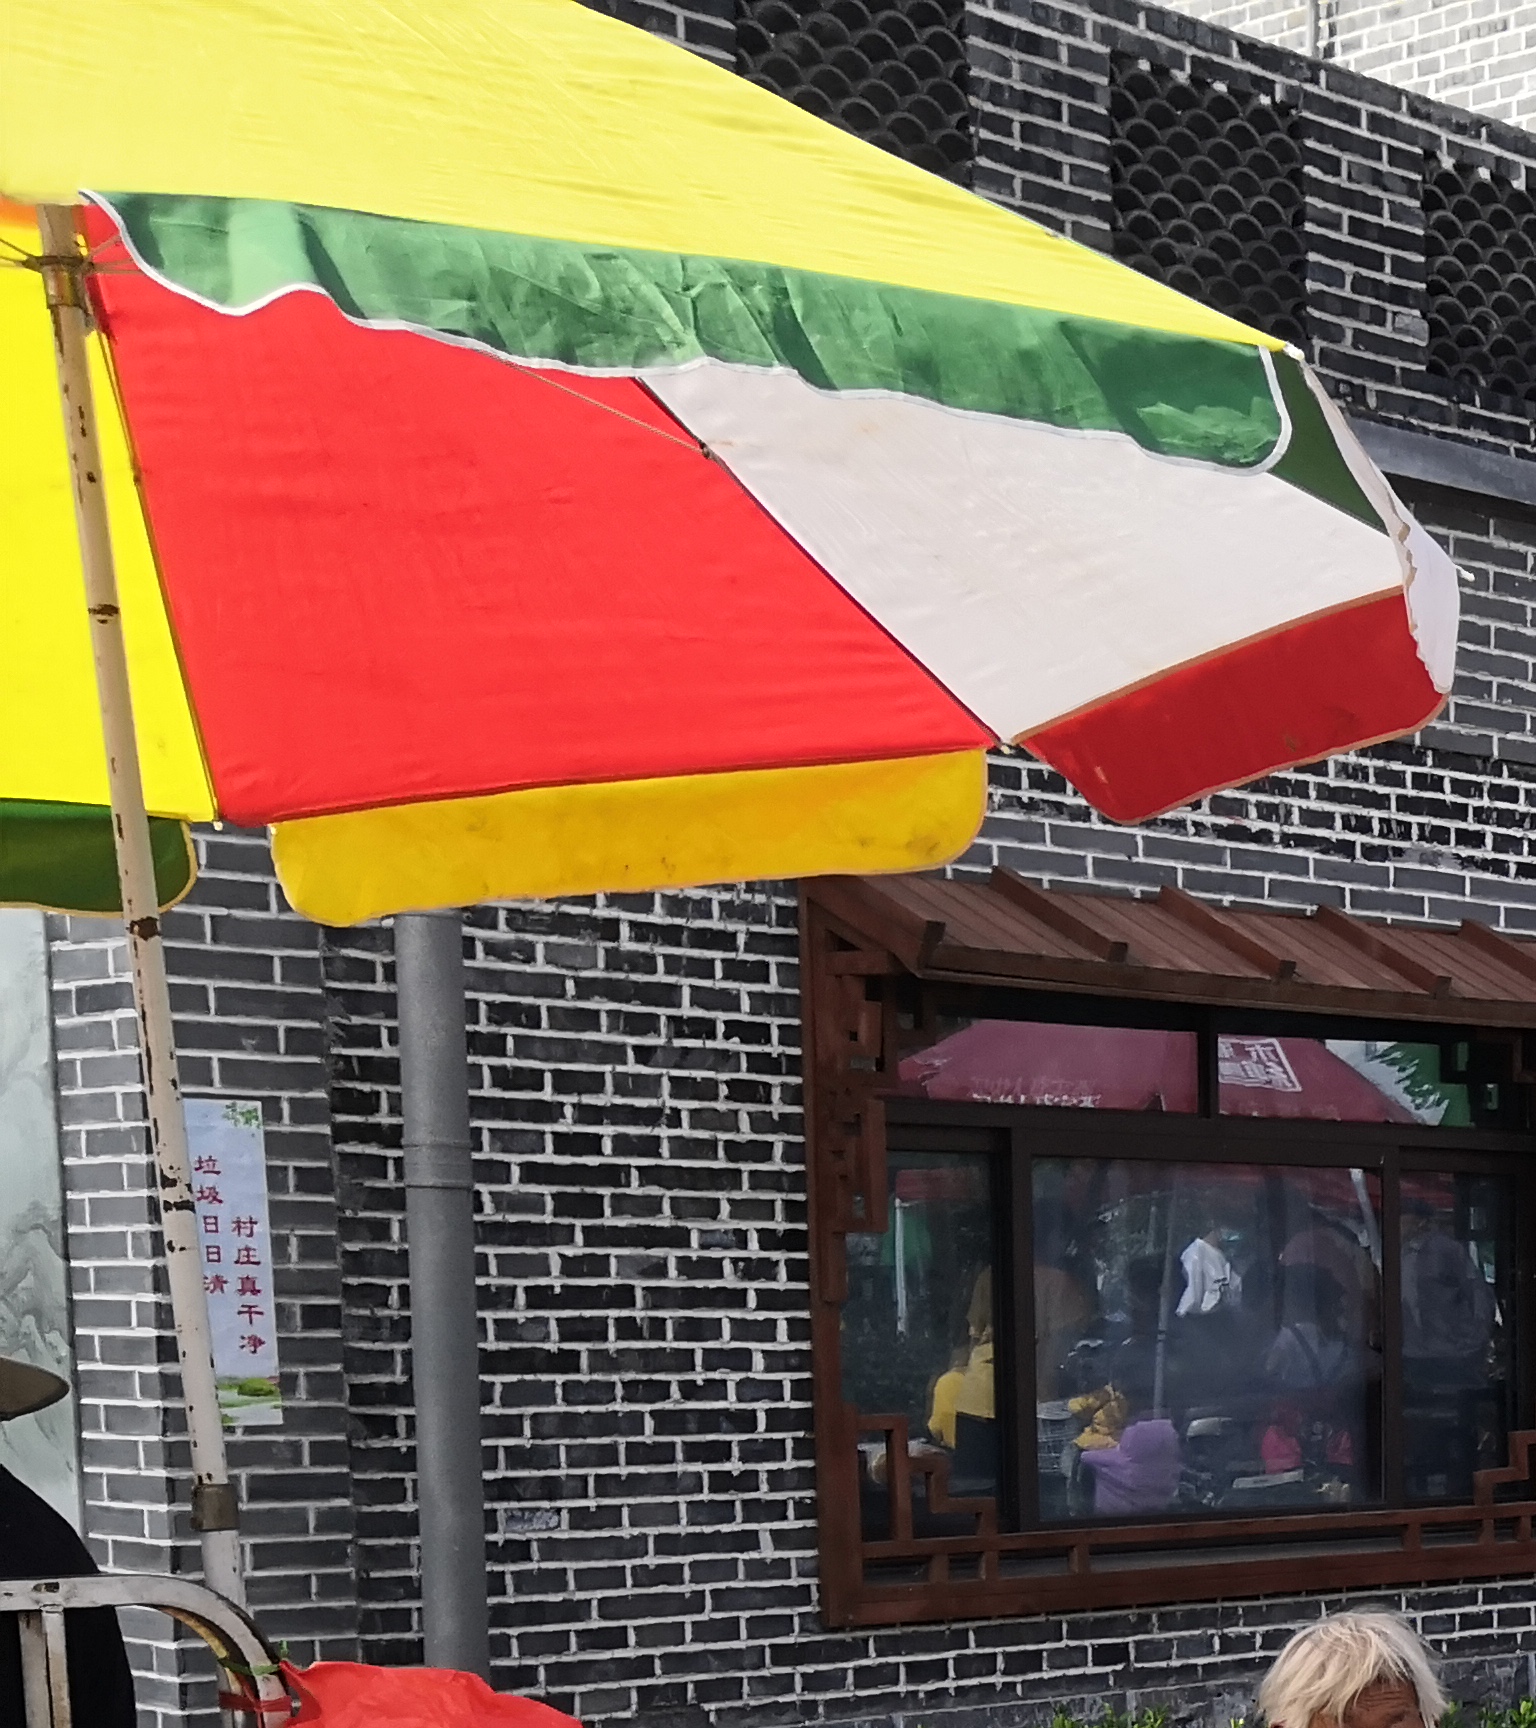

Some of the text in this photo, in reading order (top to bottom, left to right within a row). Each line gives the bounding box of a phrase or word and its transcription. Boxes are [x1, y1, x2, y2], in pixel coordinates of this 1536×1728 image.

[194, 1155, 229, 1295] 垃圾日日清
[231, 1216, 266, 1355] 村庄真干净
